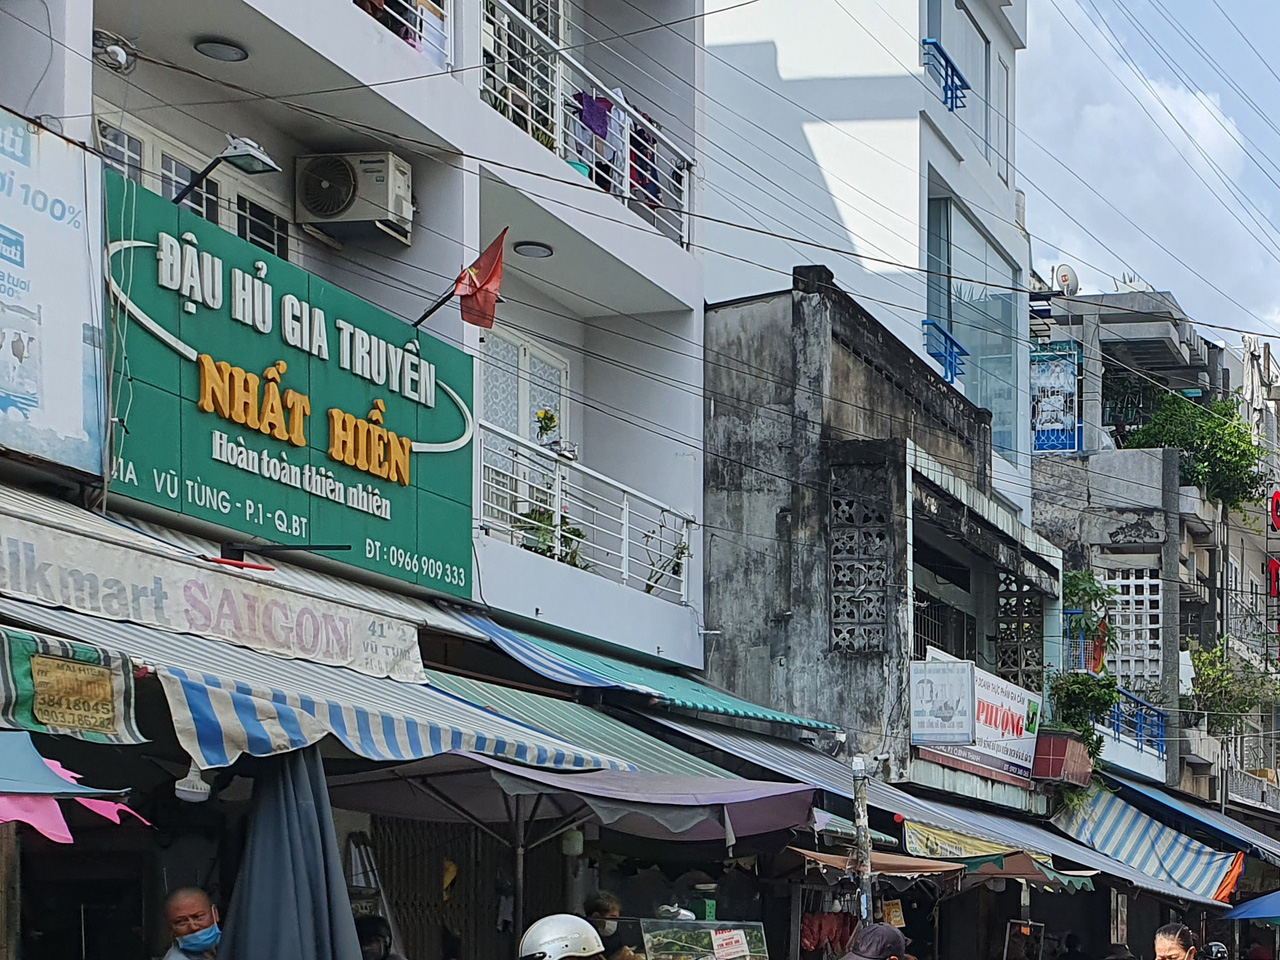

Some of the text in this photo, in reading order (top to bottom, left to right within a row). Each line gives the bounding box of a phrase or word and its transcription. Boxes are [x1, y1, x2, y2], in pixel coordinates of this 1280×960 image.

[20, 183, 82, 229] 100%
[157, 232, 435, 408] ĐẬU HỦ GIA TRUYỀN
[153, 468, 179, 499] VŨ
[185, 476, 232, 514] TÙNG
[212, 430, 391, 520] Hoàn toàn thiên nhiên
[389, 544, 419, 574] 0966
[421, 552, 443, 579] 909
[444, 558, 465, 587] 333
[183, 578, 354, 662] SAIGON
